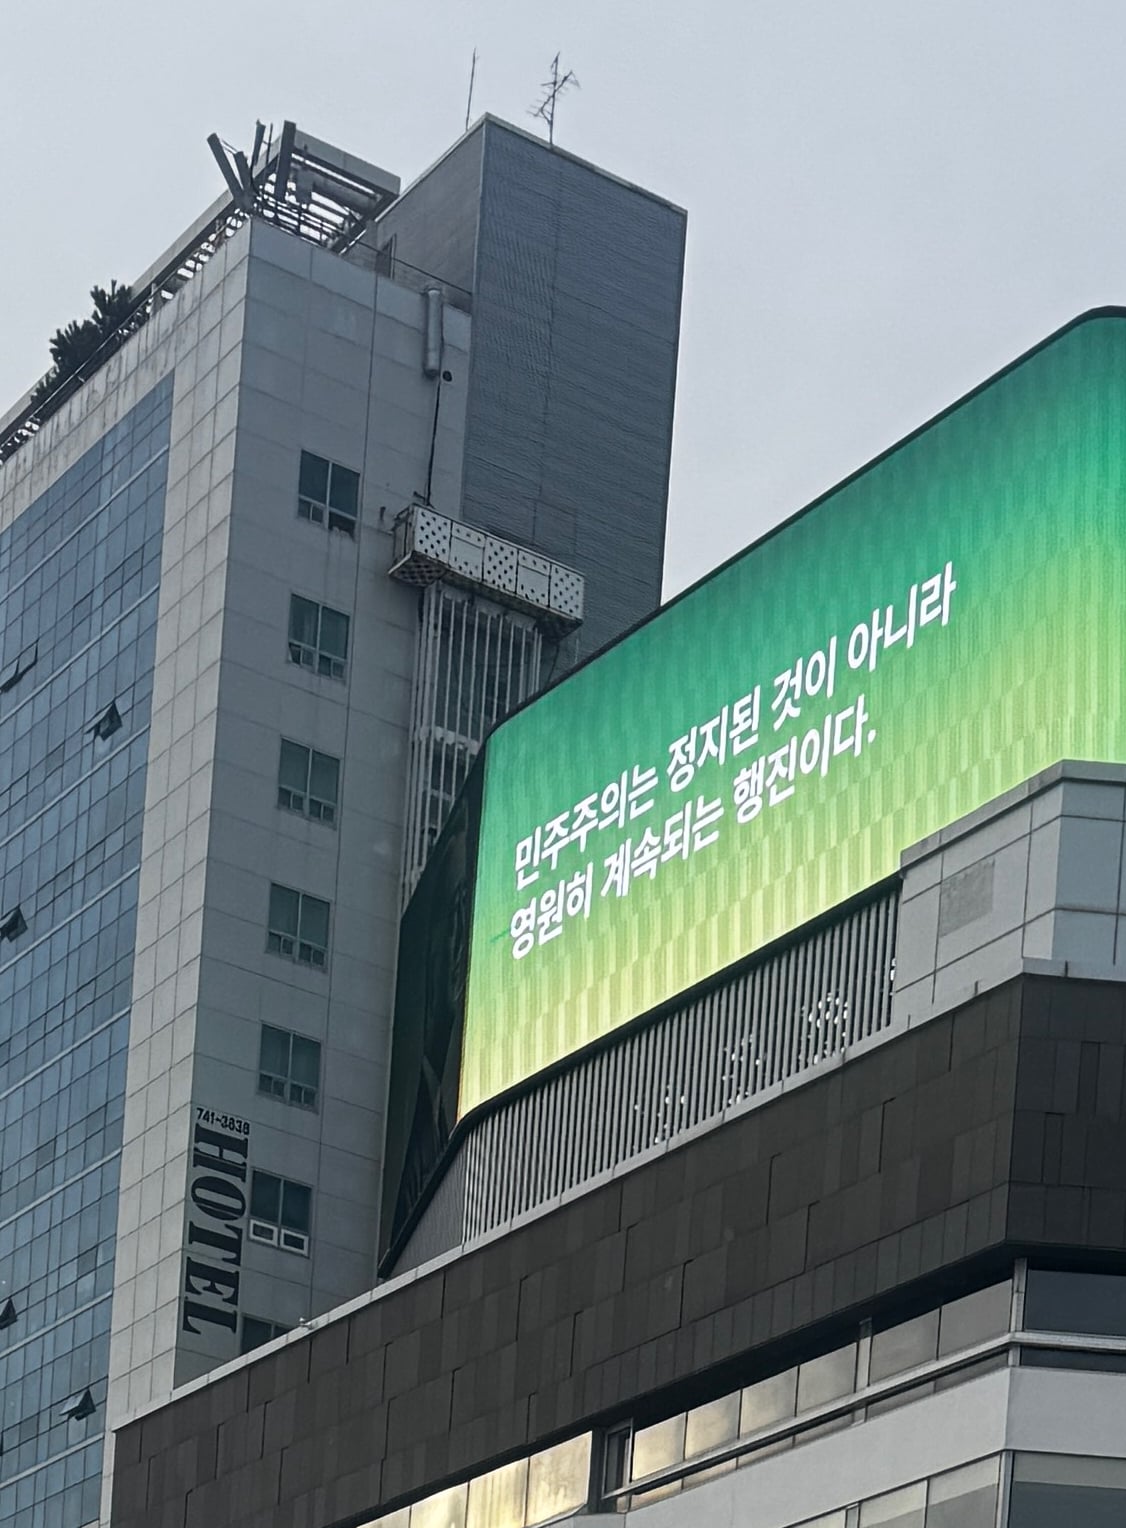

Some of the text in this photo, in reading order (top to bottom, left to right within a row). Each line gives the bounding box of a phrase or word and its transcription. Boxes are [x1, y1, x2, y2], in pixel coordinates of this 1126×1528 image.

[510, 694, 877, 960] 영원히 계속되는 행진이다.
[514, 562, 957, 890] 민주주의는 정지된 것이 아니라
[182, 1123, 249, 1335] HOTEL
